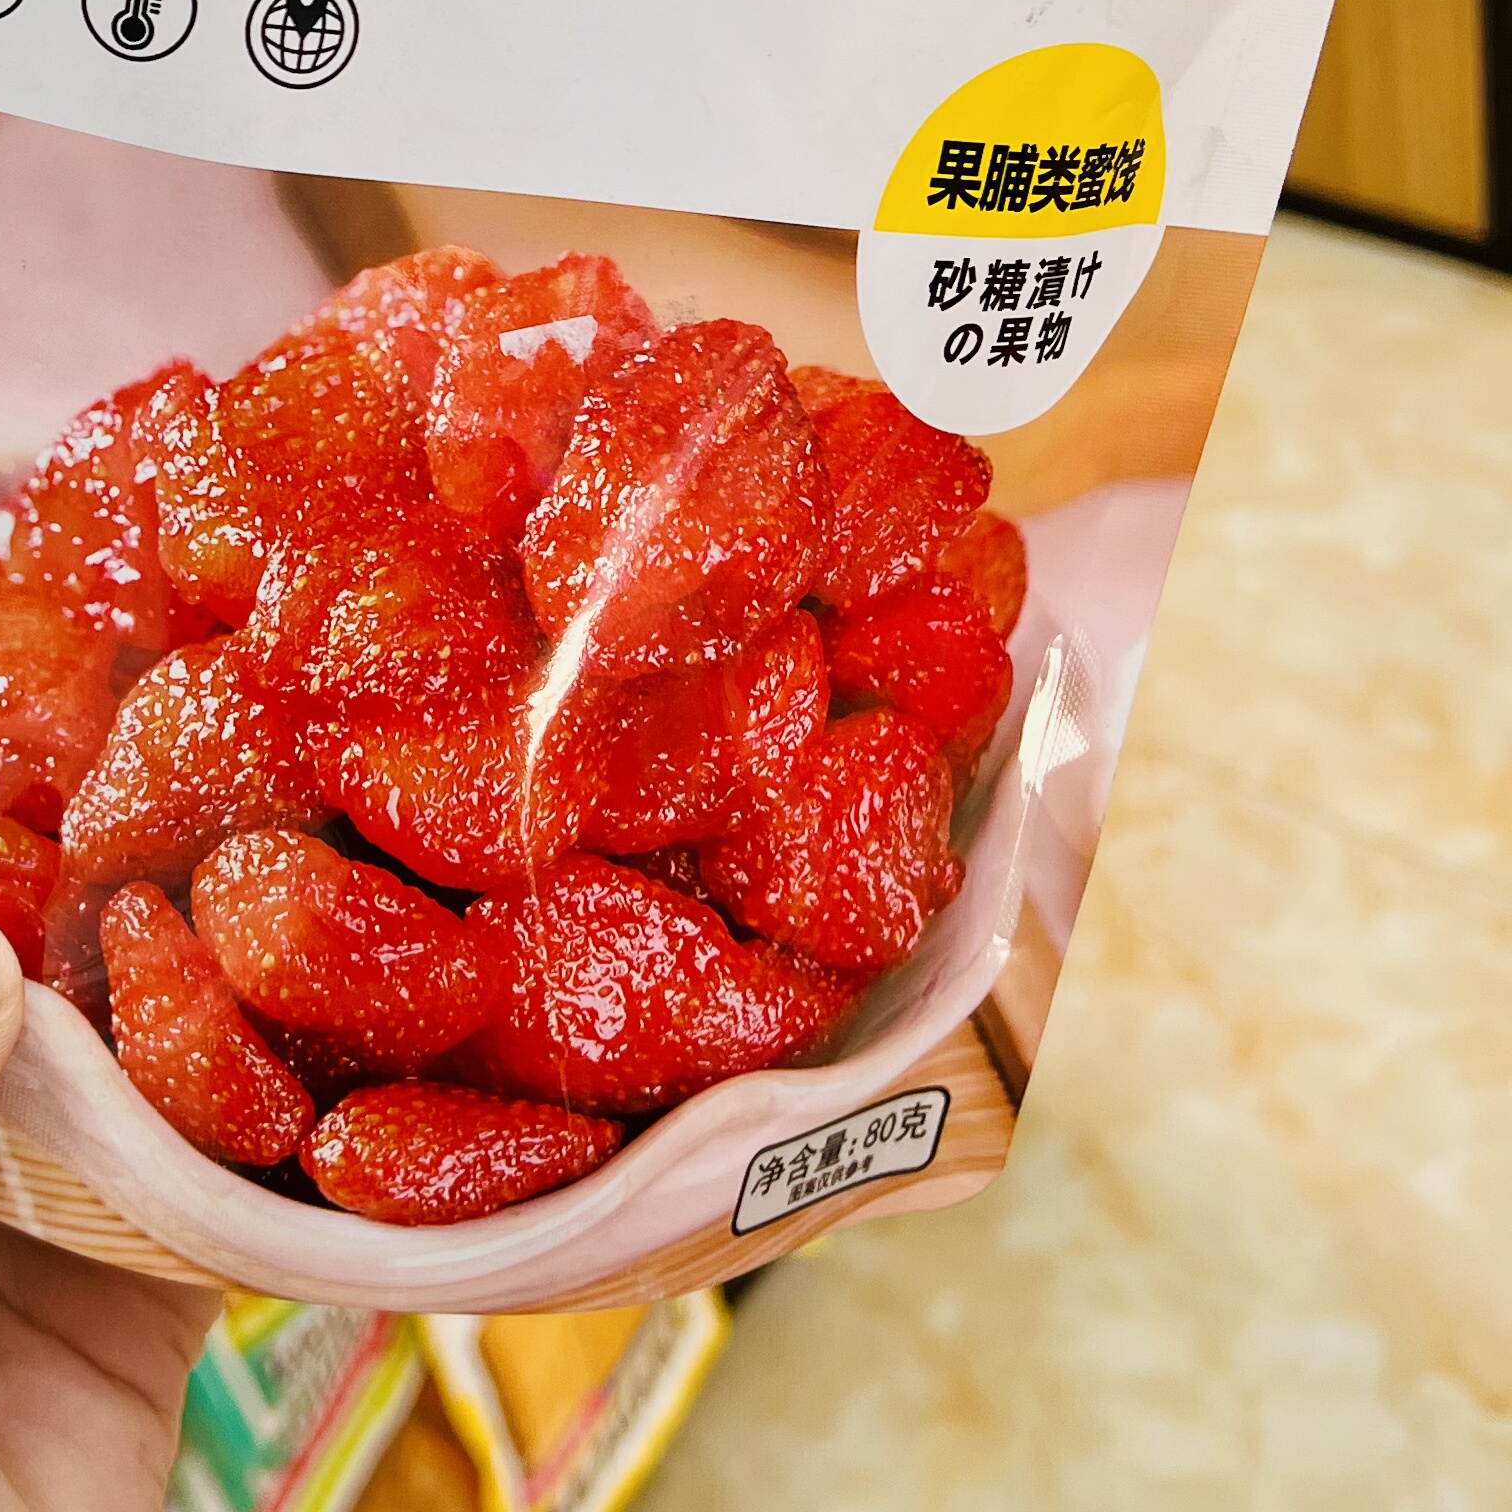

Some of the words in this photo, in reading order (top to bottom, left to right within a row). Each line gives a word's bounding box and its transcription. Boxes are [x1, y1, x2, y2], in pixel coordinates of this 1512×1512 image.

[926, 137, 1146, 214] 果脯类蜜饯
[943, 311, 1073, 368] の果物
